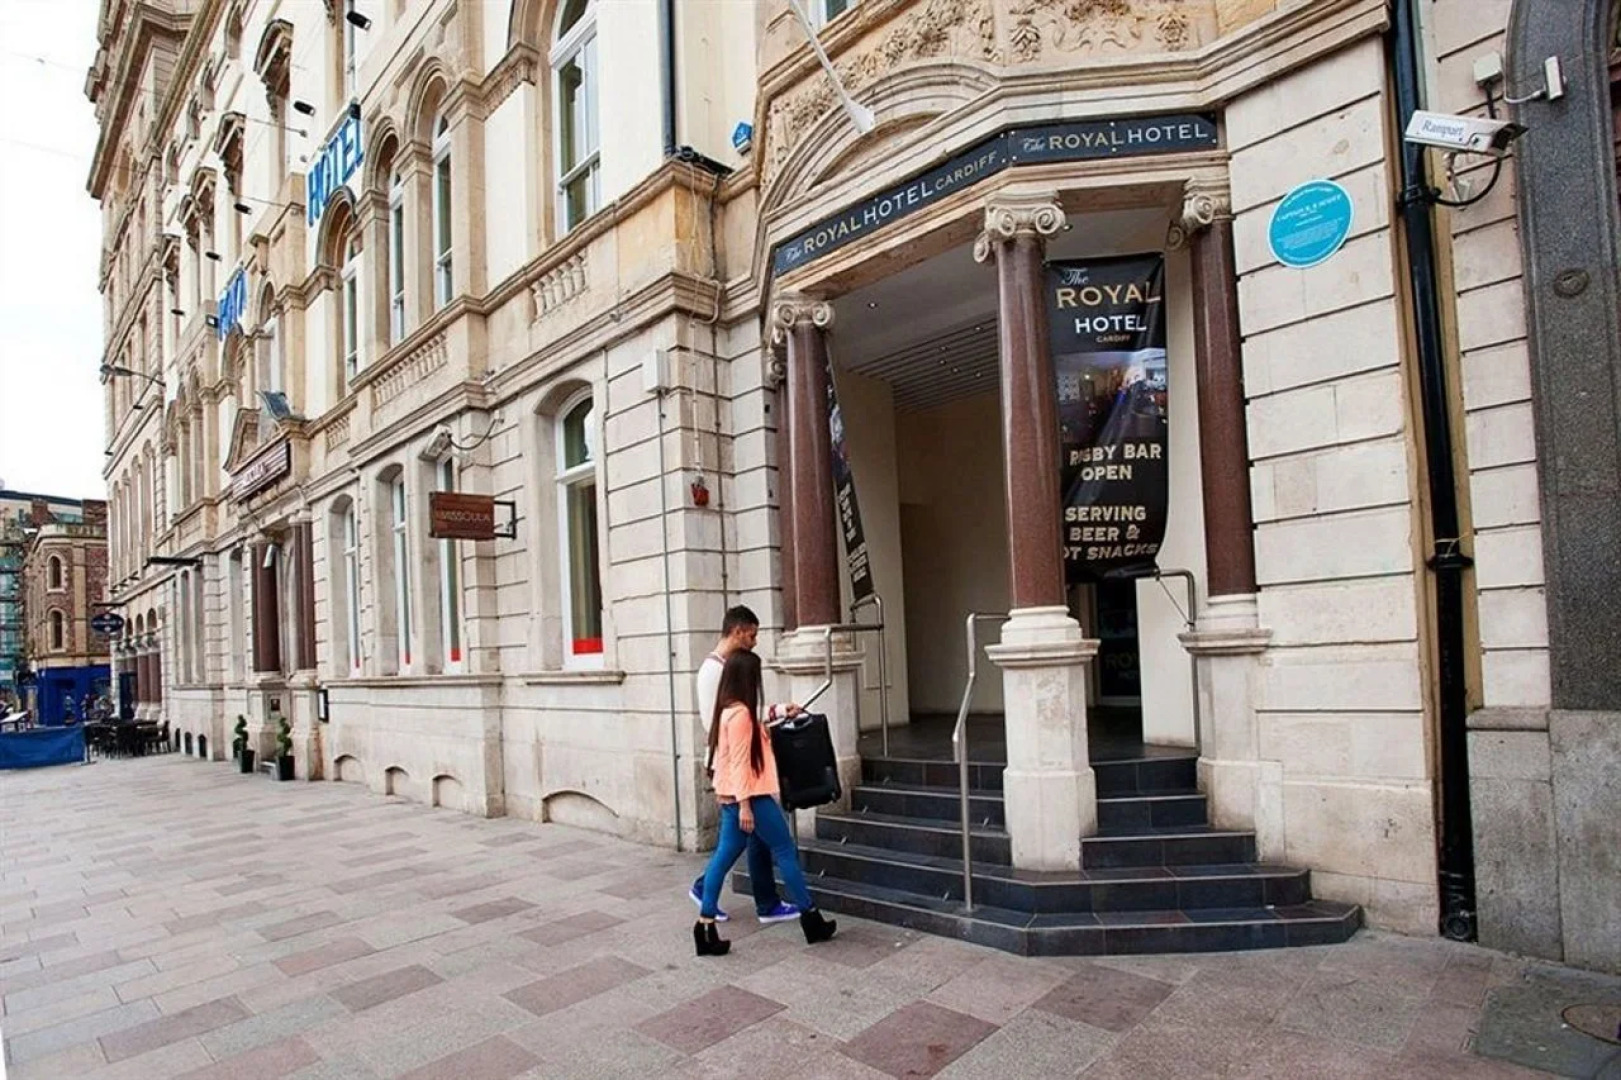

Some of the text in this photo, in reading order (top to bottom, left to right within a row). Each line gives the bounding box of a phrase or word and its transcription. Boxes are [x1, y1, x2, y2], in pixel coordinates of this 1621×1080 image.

[1050, 131, 1124, 149] ROYAL
[1128, 123, 1208, 143] HOTEL
[308, 118, 365, 227] HOTEL
[803, 217, 862, 254] ROYAL
[863, 181, 933, 224] HOTEL
[935, 151, 998, 190] CARDIFF
[1062, 267, 1089, 285] The
[1056, 281, 1161, 309] ROYAL
[1075, 315, 1147, 333] HOTEL
[1124, 443, 1162, 459] BAR
[1081, 465, 1132, 481] OPEN
[1064, 506, 1147, 521] SERVING
[1070, 524, 1140, 541] BEER &
[1087, 543, 1159, 560] SNACKS
